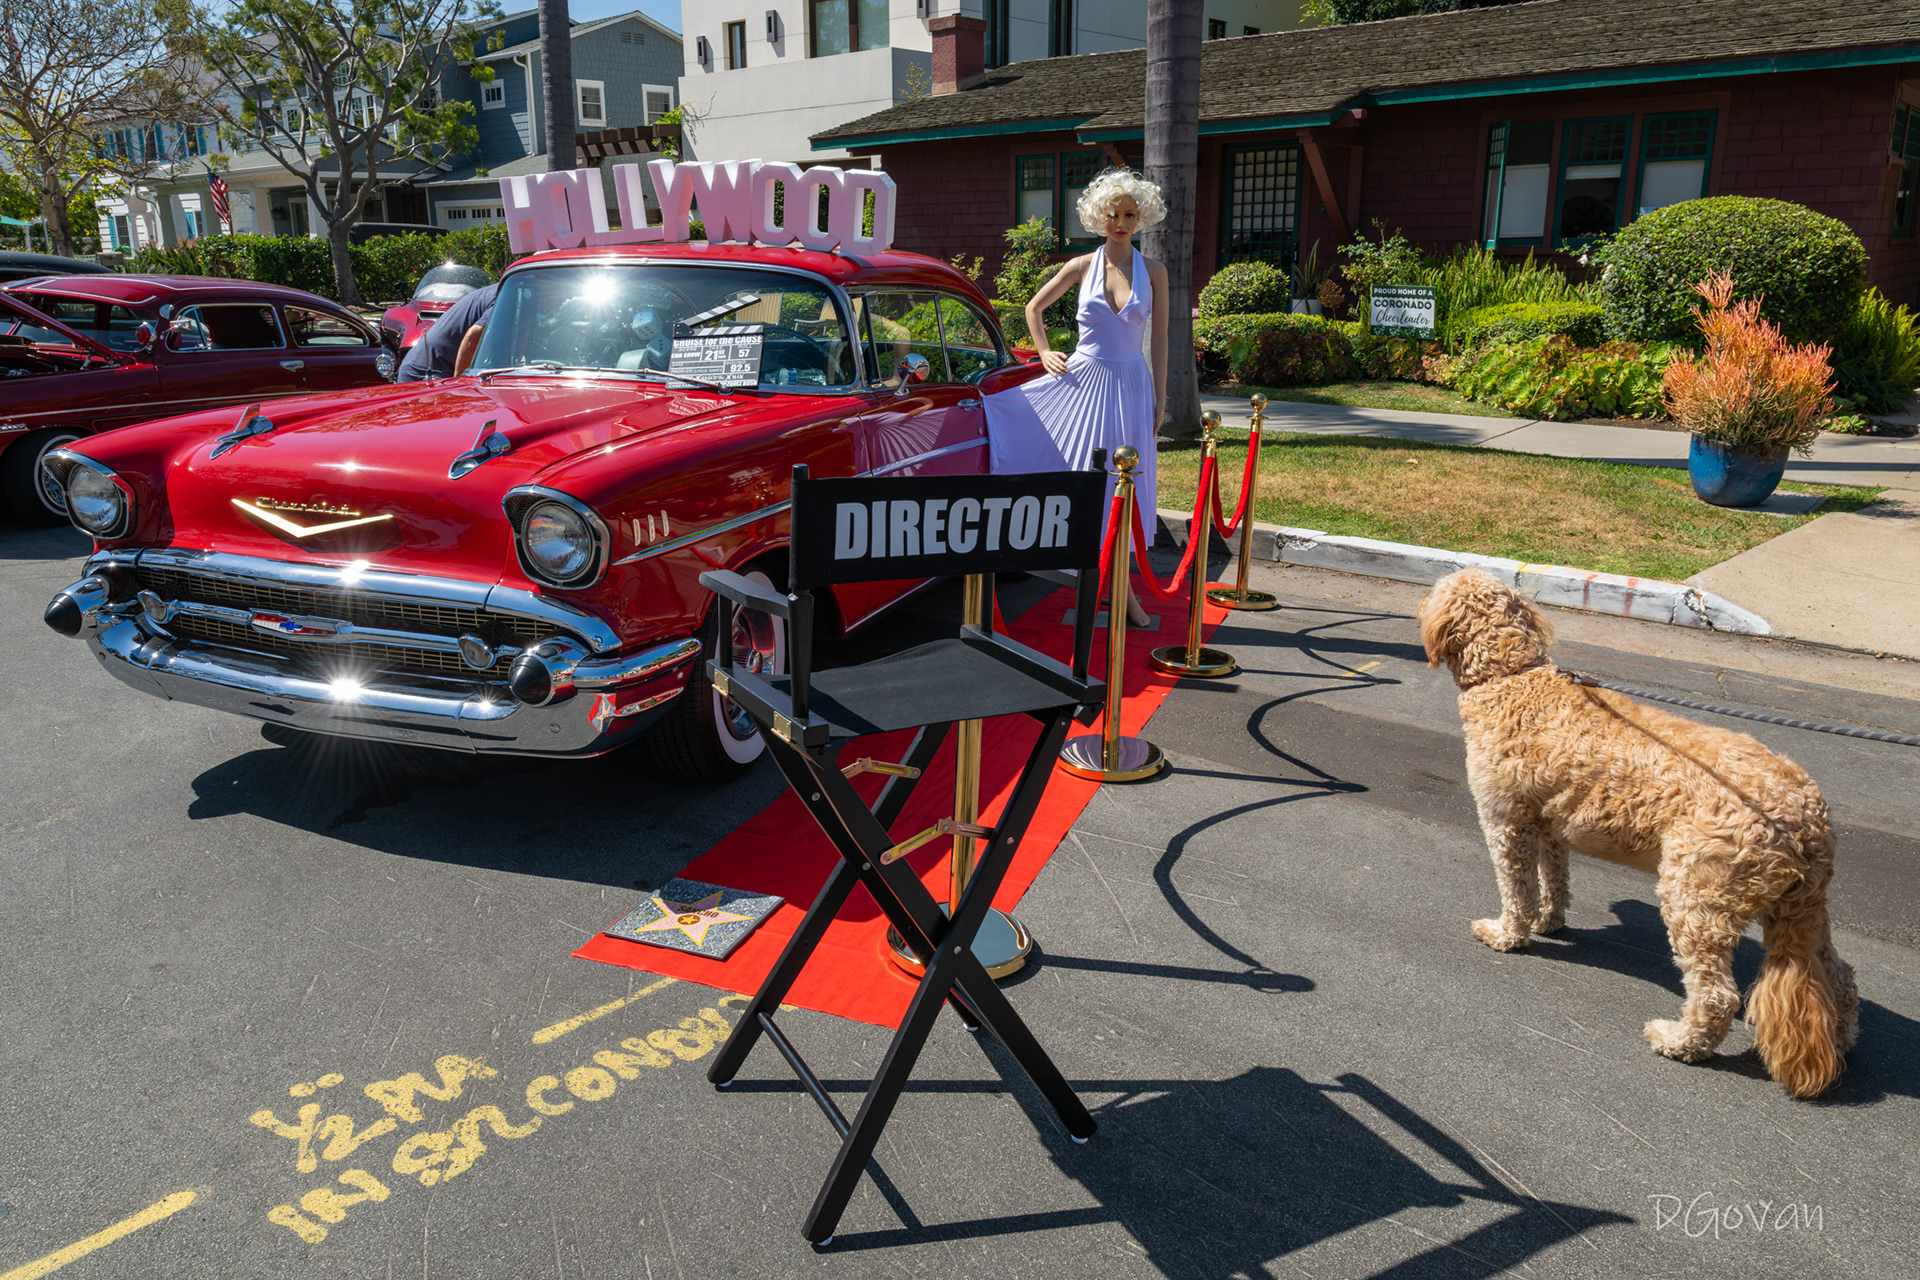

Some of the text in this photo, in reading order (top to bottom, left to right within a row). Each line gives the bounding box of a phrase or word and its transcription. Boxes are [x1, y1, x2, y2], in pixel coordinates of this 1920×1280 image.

[500, 158, 897, 256] HOLLYWOOD
[1374, 299, 1432, 310] CORONADO
[1375, 307, 1431, 325] Cheerleader
[673, 338, 704, 347] CRUISE
[705, 337, 718, 346] for
[735, 334, 762, 344] CAUSE
[738, 349, 750, 358] 57
[730, 363, 751, 372] 92.5
[255, 497, 358, 515] Chevrolet
[834, 495, 1071, 560] DIRECTOR
[677, 905, 720, 919] SANCHO
